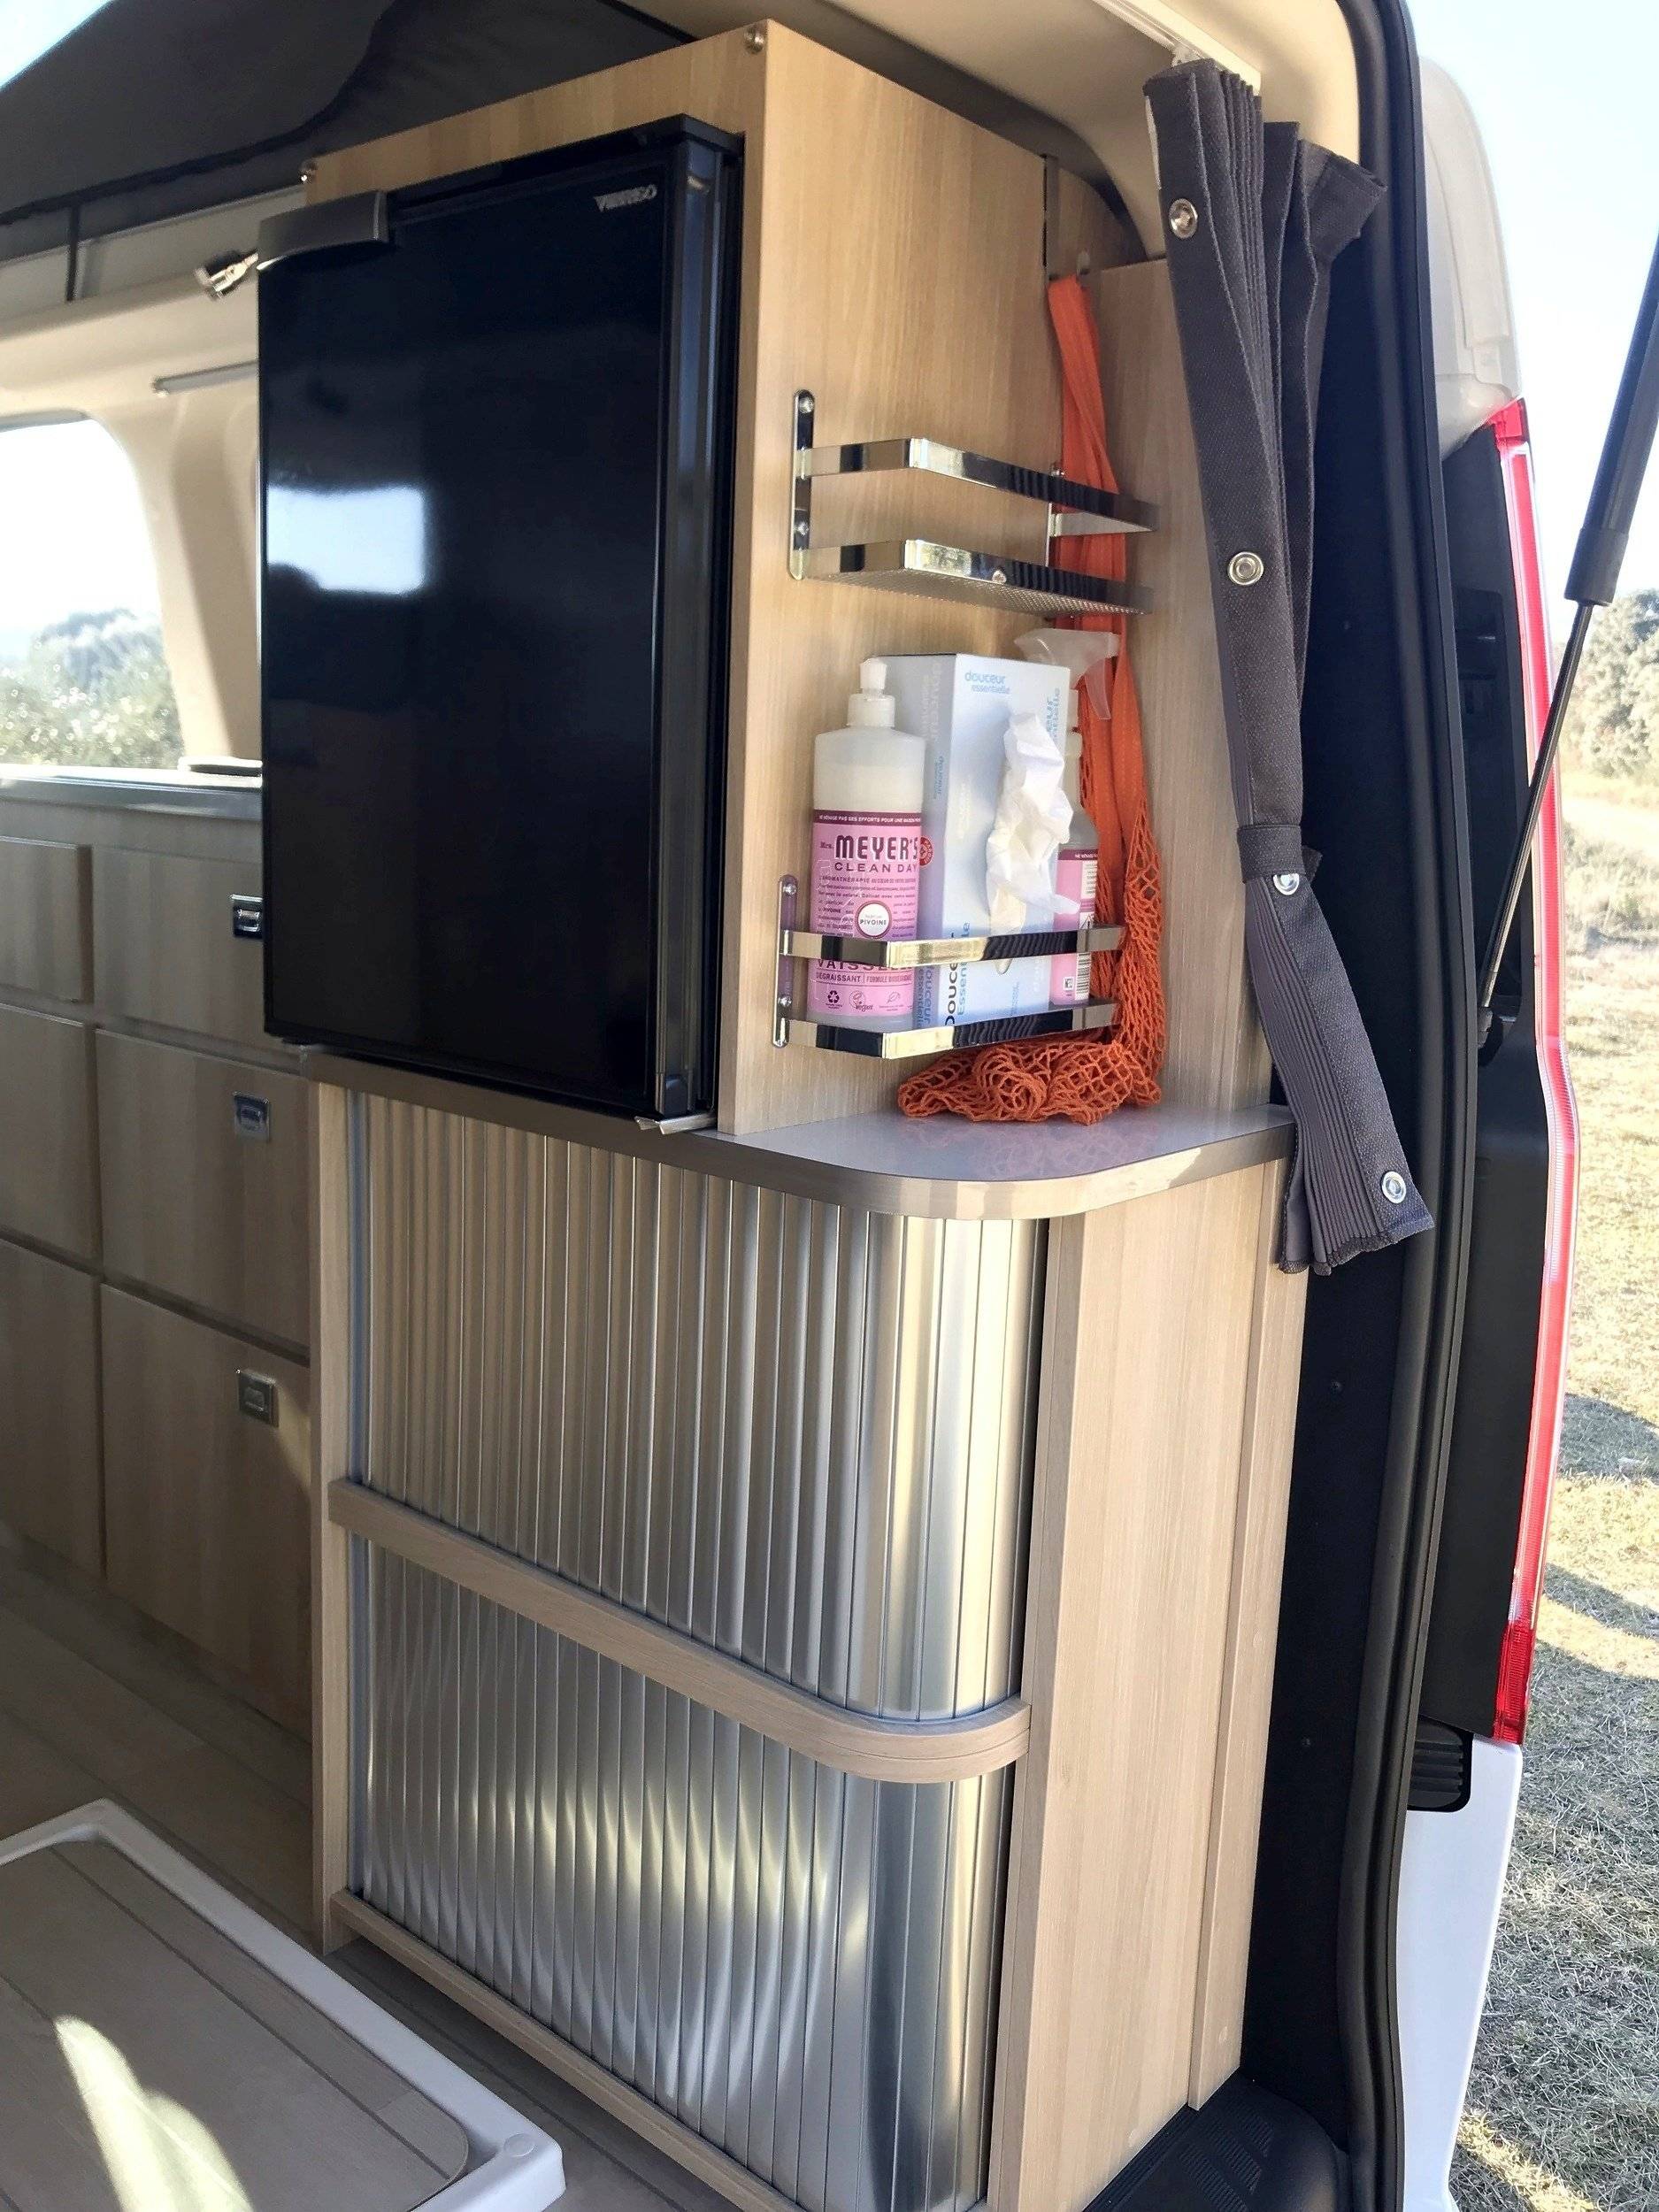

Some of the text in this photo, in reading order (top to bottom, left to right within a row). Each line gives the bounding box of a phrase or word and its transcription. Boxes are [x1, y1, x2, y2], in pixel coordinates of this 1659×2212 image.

[964, 670, 1006, 685] douceur
[835, 835, 918, 860] MEYER'S
[834, 862, 891, 873] CLEAN
